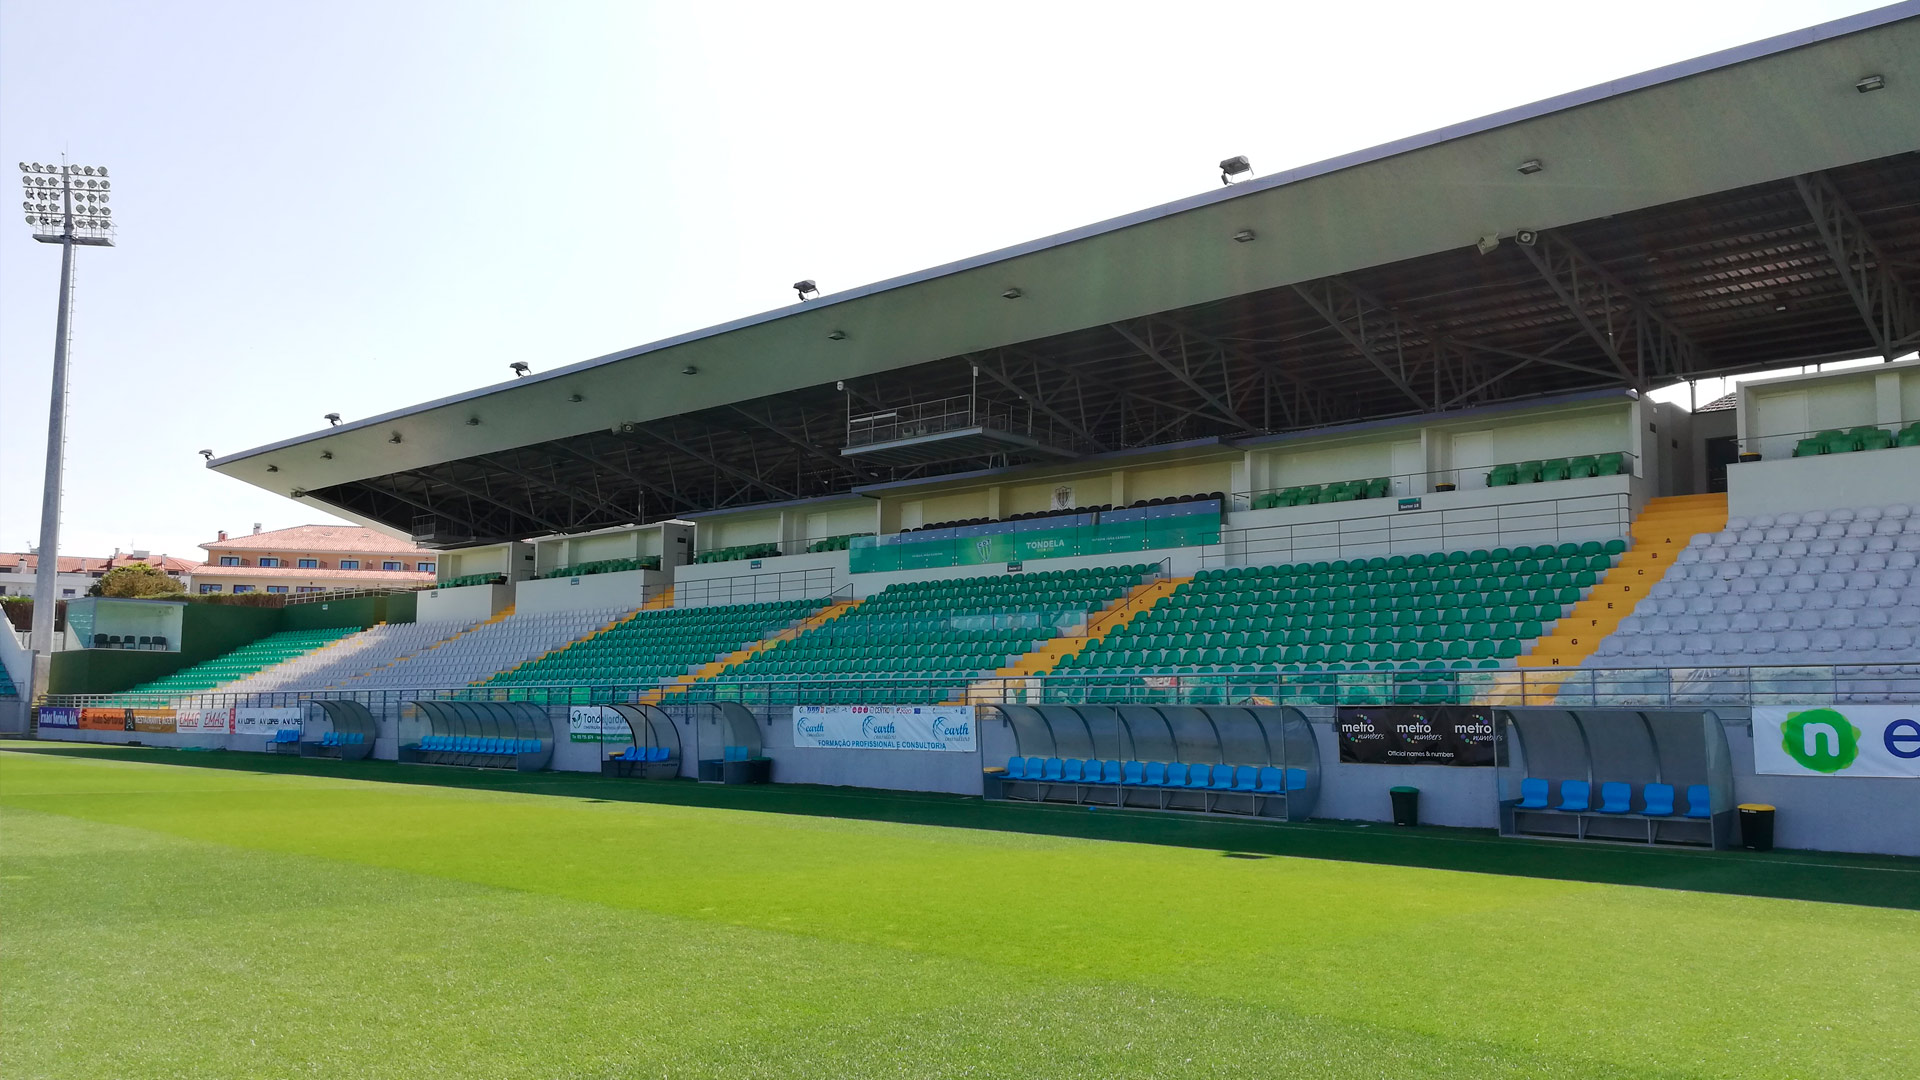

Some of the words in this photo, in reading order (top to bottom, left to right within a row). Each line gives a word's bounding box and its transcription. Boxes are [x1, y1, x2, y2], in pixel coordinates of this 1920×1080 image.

[1026, 539, 1065, 550] TONDELA
[179, 712, 200, 726] EMAG
[204, 711, 226, 726] EMAG
[805, 722, 824, 732] earth
[873, 721, 895, 734] earth
[944, 722, 969, 735] earth
[1341, 721, 1375, 733] metro
[1396, 722, 1432, 733] metro
[1454, 722, 1492, 734] metro
[1414, 733, 1443, 741] numbers
[1803, 722, 1840, 757] n
[818, 739, 851, 747] FORMAÇÃO
[852, 740, 896, 748] PROFISSIONAL
[896, 741, 901, 749] E
[902, 741, 947, 750] CONSULTORIA
